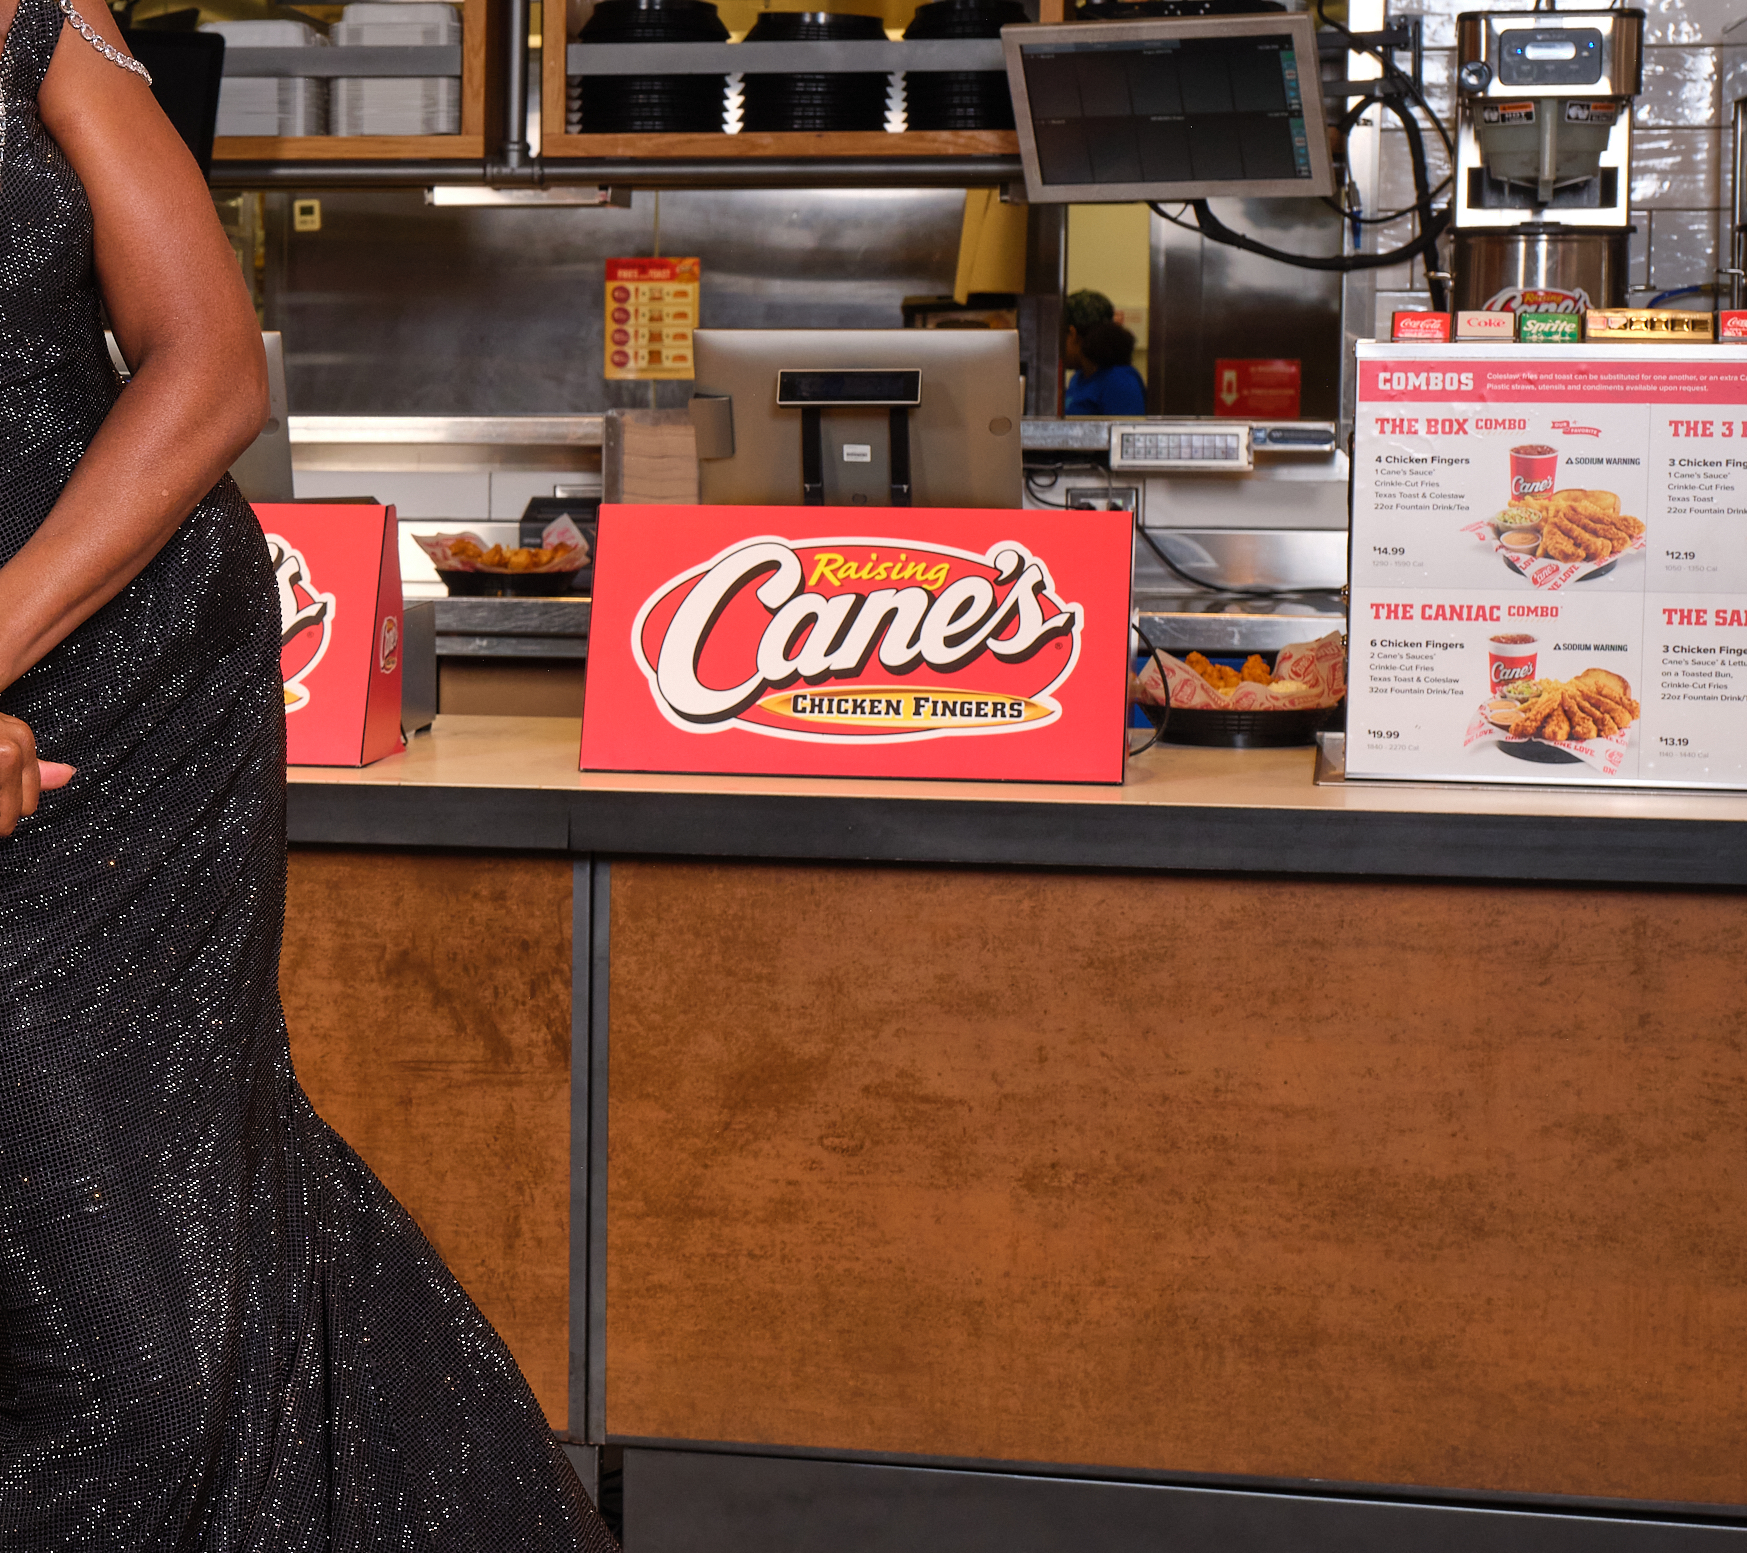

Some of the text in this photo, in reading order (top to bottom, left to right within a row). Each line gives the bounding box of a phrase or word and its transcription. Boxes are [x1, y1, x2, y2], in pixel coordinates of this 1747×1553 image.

[1467, 317, 1505, 327] Coke
[1523, 319, 1576, 334] Sprite
[1378, 372, 1473, 391] COMBOS
[1375, 418, 1526, 435] THE BOX COMBO
[1375, 456, 1470, 466] 4 Chicken Fingers
[1396, 503, 1430, 511] Fountain
[1373, 547, 1405, 555] $14.99
[808, 552, 951, 590] Raising
[1370, 603, 1559, 622] THE CANIAC COMBO
[657, 542, 1075, 724] Cane's
[1380, 639, 1422, 648] Chicken
[1426, 640, 1465, 650] Fingers
[793, 695, 1023, 719] CHICKEN FINGERS
[1368, 729, 1399, 739] $19.99
[1659, 737, 1689, 746] $13.19
